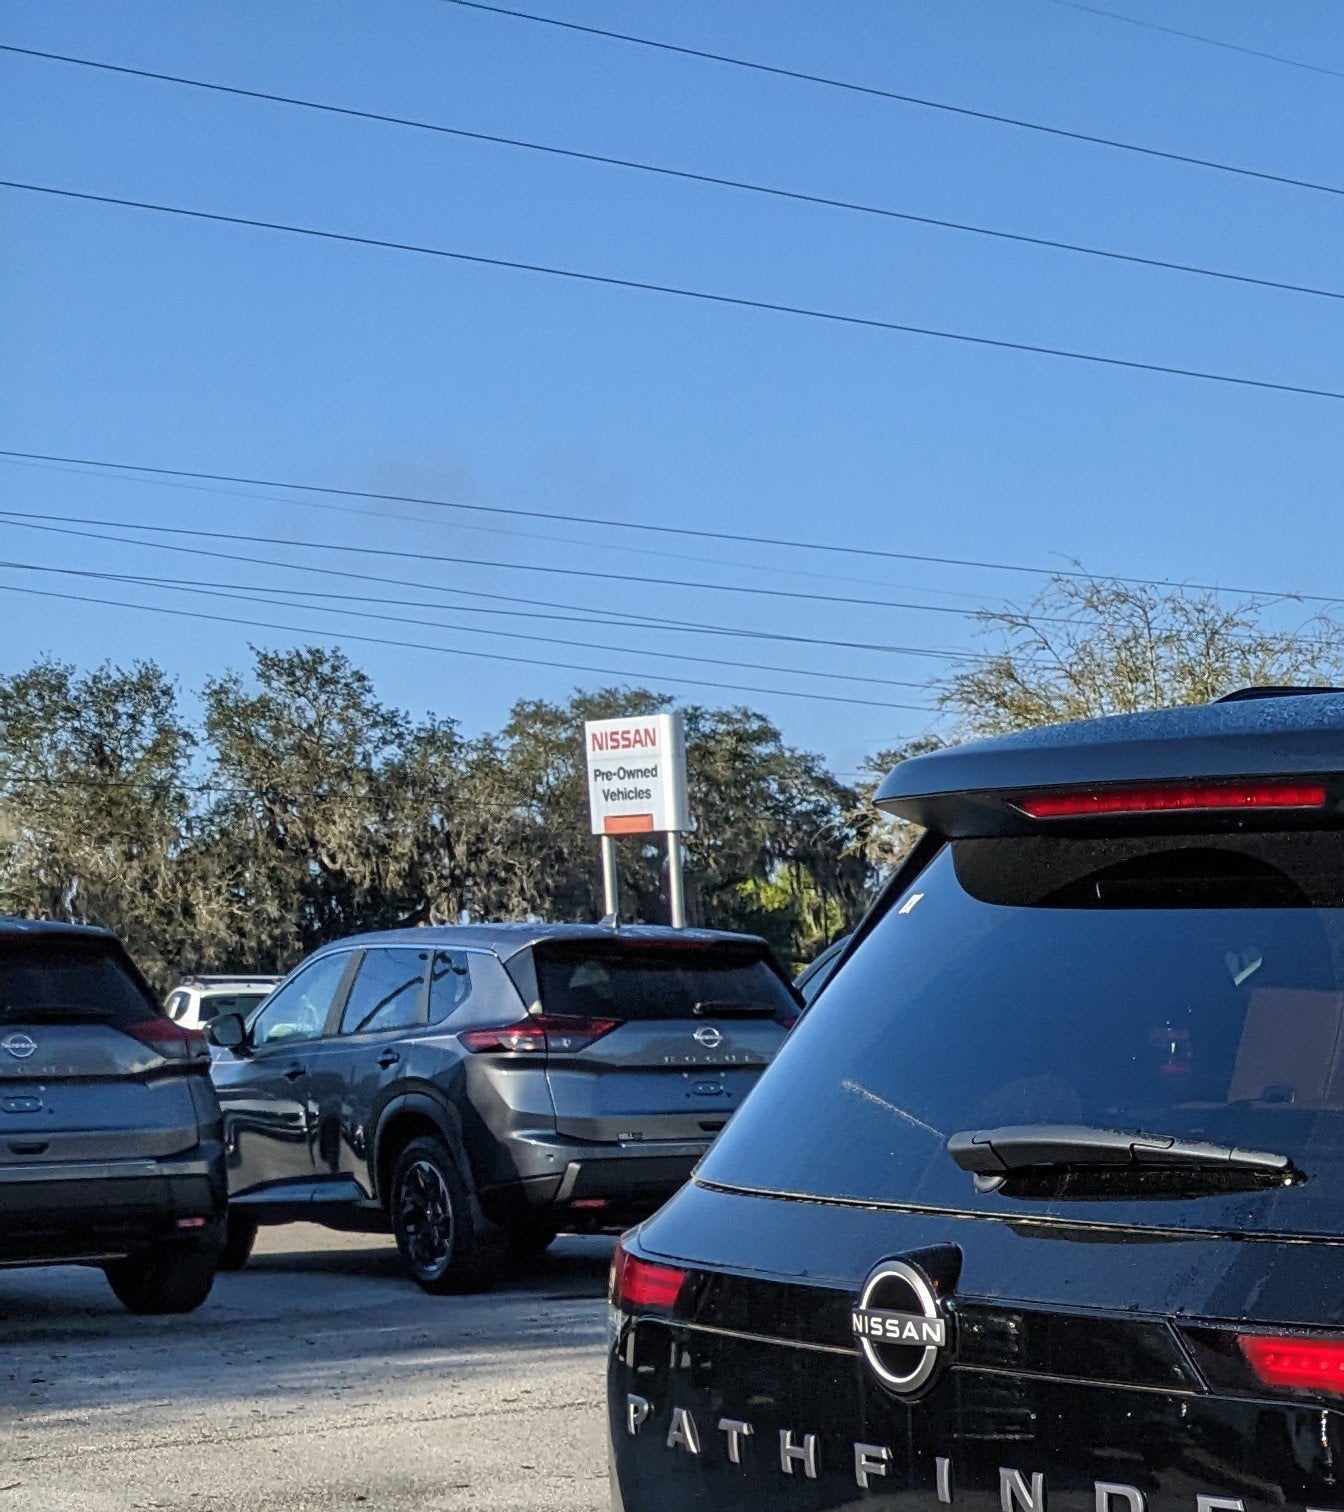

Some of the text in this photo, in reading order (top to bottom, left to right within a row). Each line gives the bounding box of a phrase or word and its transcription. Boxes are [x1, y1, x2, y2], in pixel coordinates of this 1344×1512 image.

[591, 727, 657, 752] NISSAN
[593, 765, 658, 782] Pre-Owned
[602, 787, 652, 801] Vehicles
[852, 1313, 941, 1342] NISSAN
